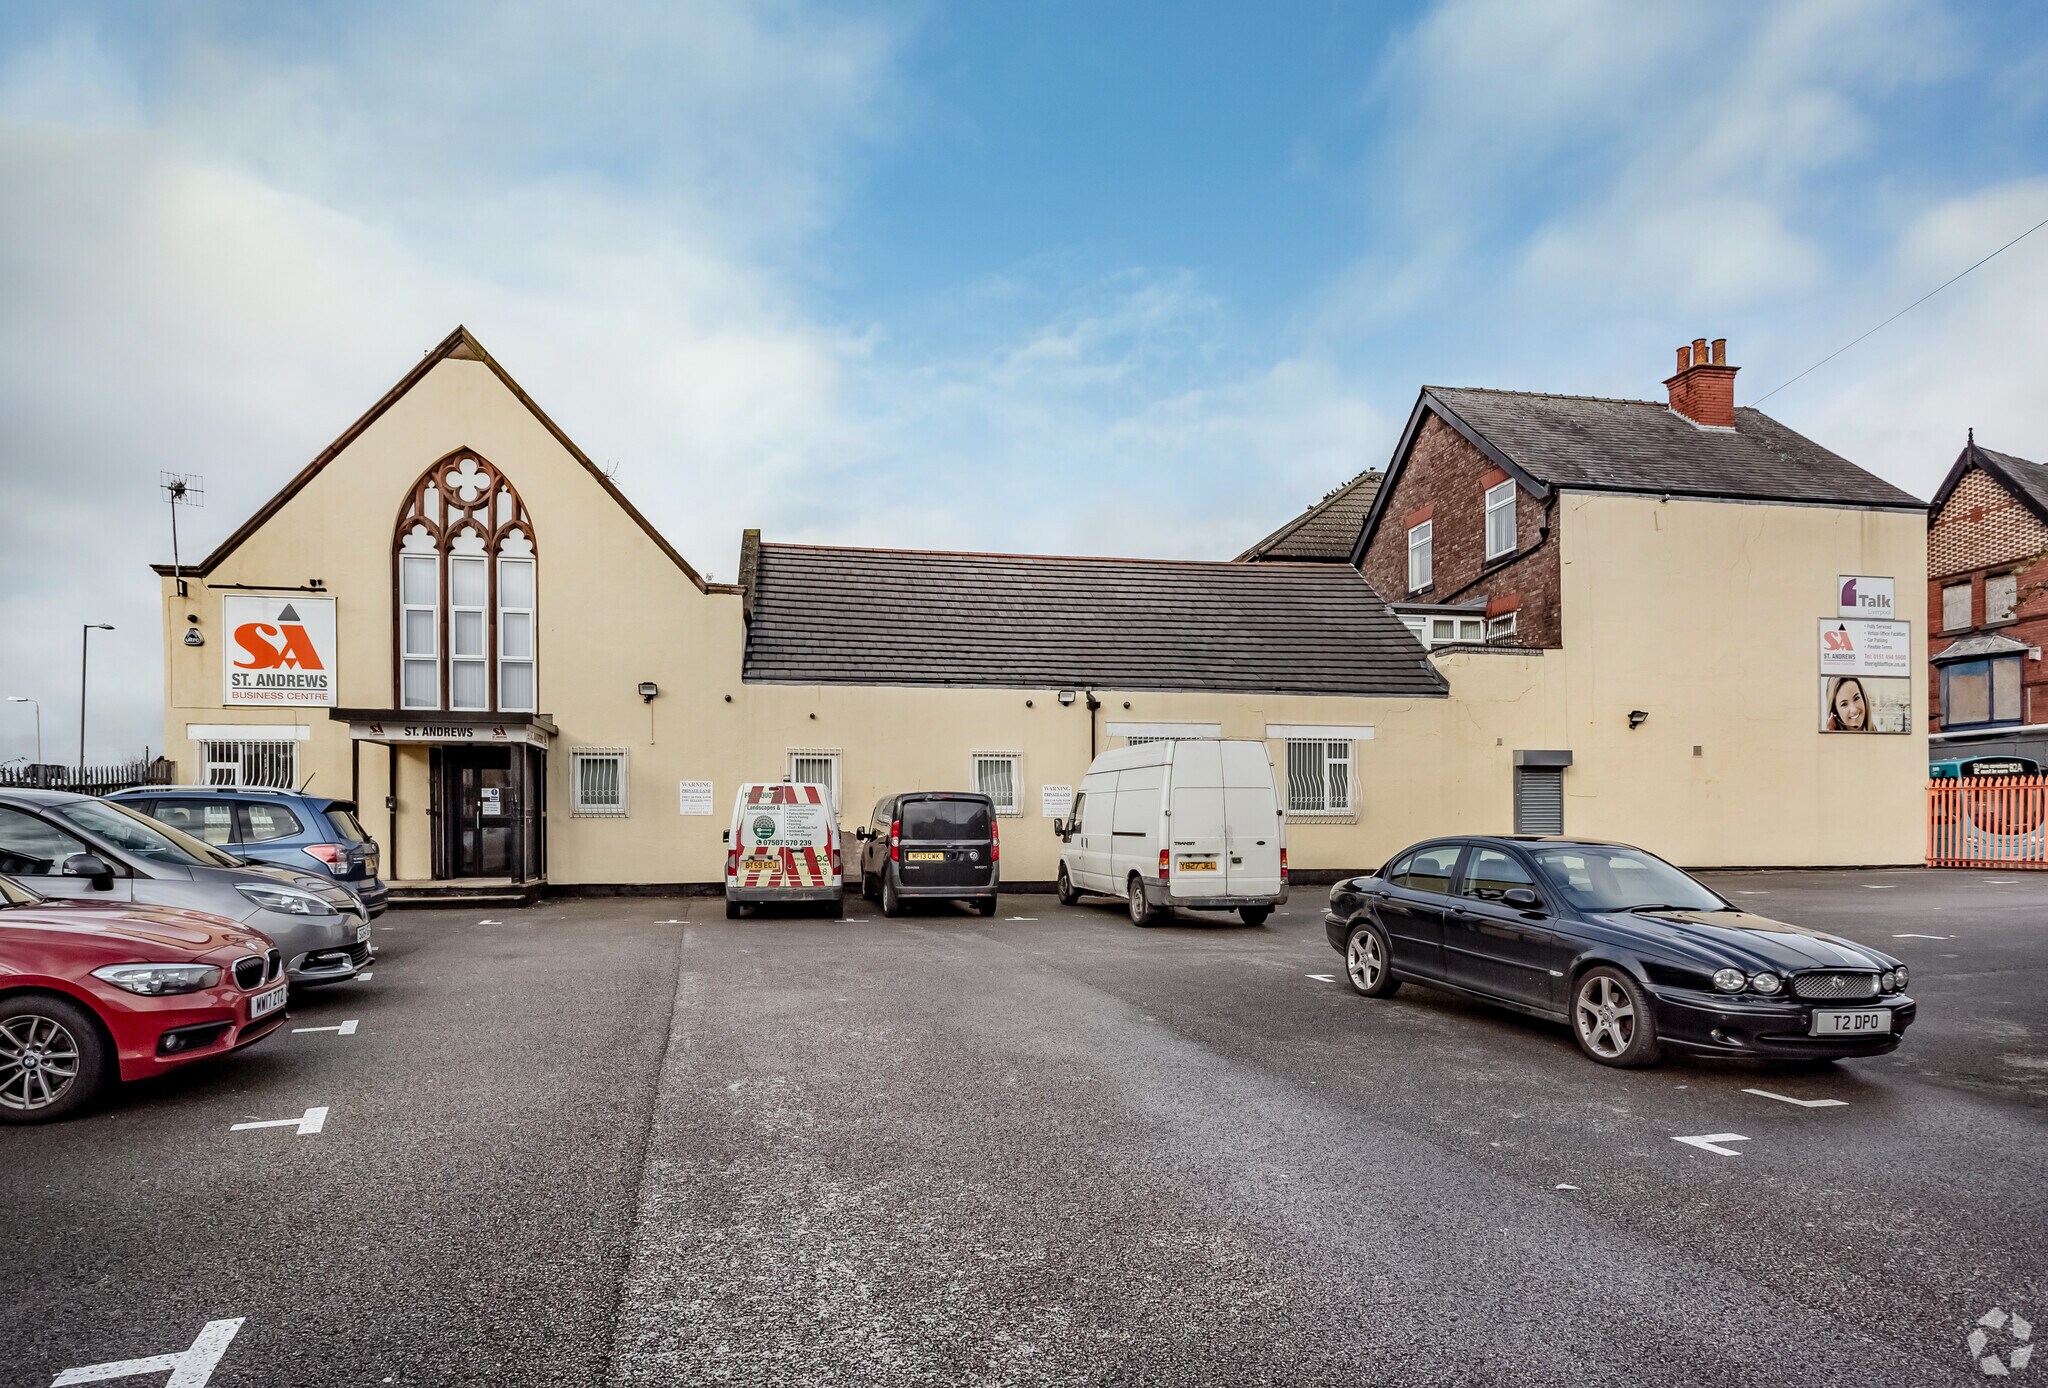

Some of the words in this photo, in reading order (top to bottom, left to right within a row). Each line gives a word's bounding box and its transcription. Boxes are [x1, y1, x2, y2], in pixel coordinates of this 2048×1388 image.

[1858, 594, 1891, 608] Talk
[231, 673, 252, 687] ST.
[256, 673, 328, 688] ANDREWS
[232, 691, 284, 700] BUSINESS
[287, 692, 328, 701] CENTRE
[405, 727, 419, 737] ST.
[422, 727, 474, 738] ANDREWS
[1833, 1015, 1850, 1030] T2
[1854, 1014, 1878, 1029] DPO
